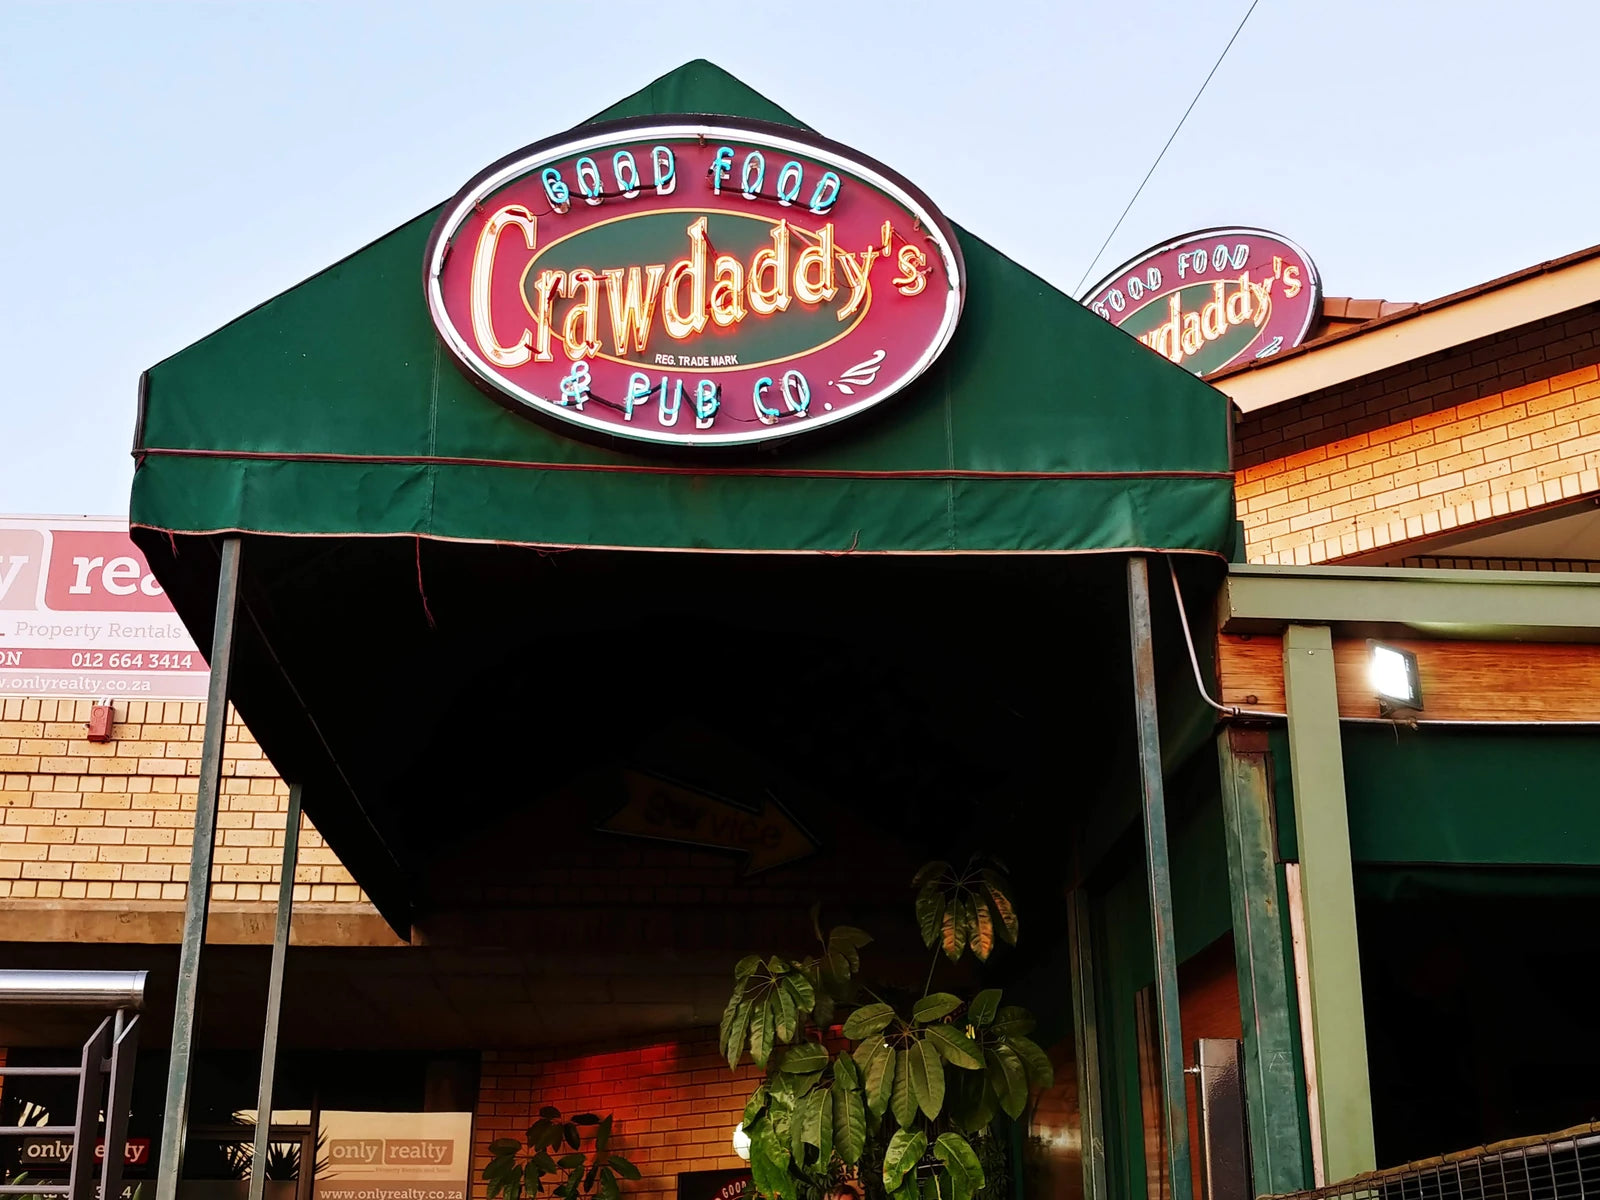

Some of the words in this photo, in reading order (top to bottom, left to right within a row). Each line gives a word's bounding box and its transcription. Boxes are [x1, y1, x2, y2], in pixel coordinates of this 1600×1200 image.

[541, 145, 678, 215] GOOD
[708, 146, 843, 215] FOOD
[469, 204, 929, 369] Crawdaddy's
[1092, 266, 1163, 321] GOOD
[1178, 243, 1250, 279] FOOD
[655, 353, 677, 366] REG.
[678, 355, 710, 367] TRADE
[710, 354, 739, 366] MARK
[559, 360, 592, 411] &
[623, 371, 722, 429] PUB
[14, 621, 102, 642] Property
[108, 622, 182, 640] Rentals
[71, 651, 104, 668] 012
[108, 652, 144, 668] 664
[148, 653, 193, 669] 3414
[27, 1139, 75, 1162] only
[332, 1141, 379, 1163] only
[388, 1141, 448, 1163] realty
[319, 1187, 464, 1200] www.onlyrealty.co.za
